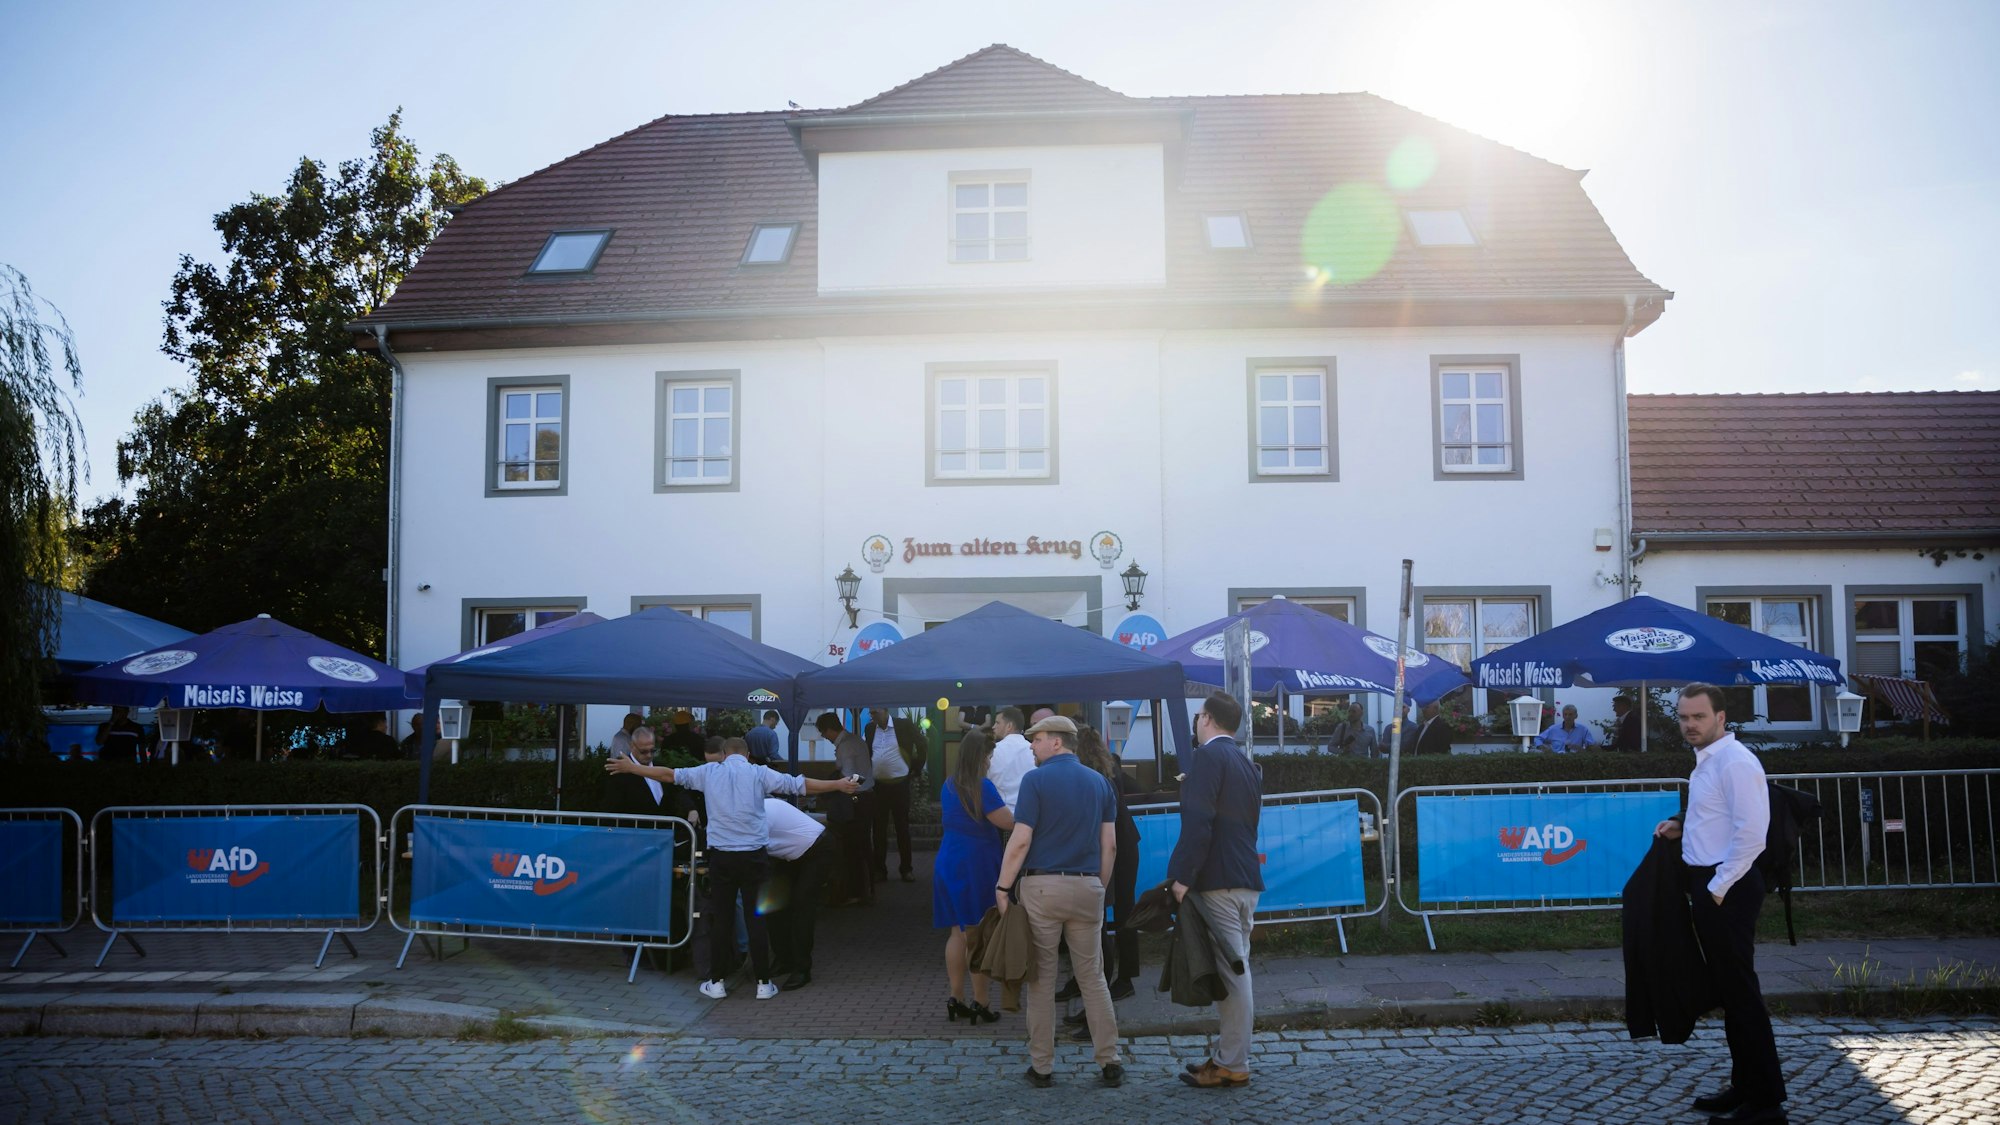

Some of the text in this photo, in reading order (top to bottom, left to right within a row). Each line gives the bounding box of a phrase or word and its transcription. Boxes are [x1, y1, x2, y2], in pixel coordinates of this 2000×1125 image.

[902, 537, 953, 563] Zum
[960, 537, 1018, 556] alten
[1025, 535, 1082, 560] Krug
[1131, 632, 1158, 646] AfD
[1644, 633, 1685, 647] Weisse
[1479, 661, 1563, 687] Maisel's Weisse
[1751, 659, 1803, 681] Maisel's
[183, 684, 304, 708] Maisel's Weisse
[1522, 824, 1574, 849] AfD
[209, 846, 258, 871] AfD
[513, 854, 565, 879] AfD
